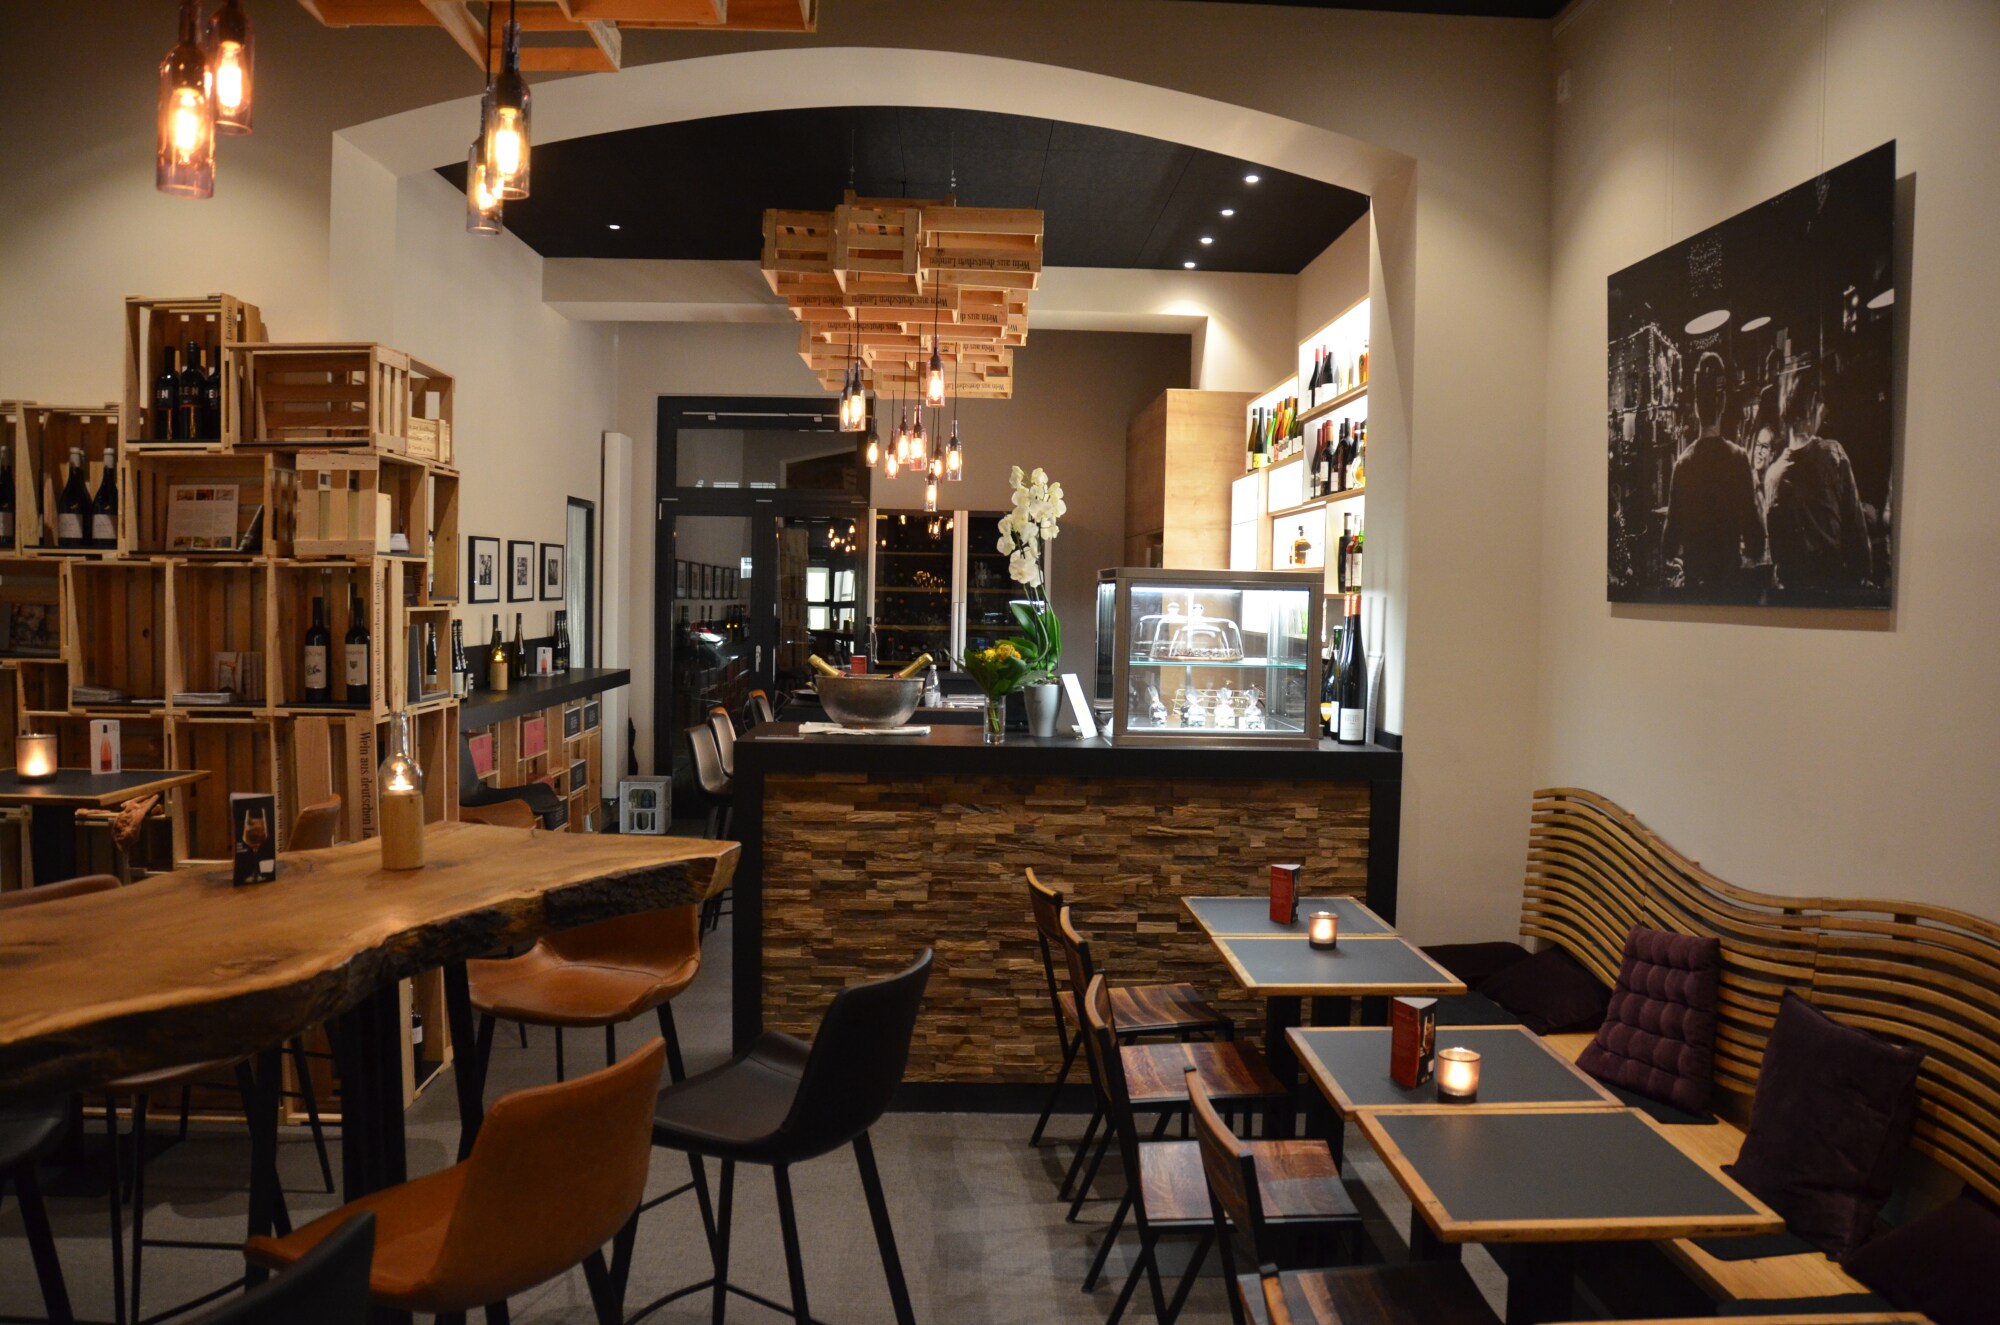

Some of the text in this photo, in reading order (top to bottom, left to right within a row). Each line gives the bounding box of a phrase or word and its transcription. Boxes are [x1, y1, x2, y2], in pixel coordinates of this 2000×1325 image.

[996, 259, 1011, 267] aus
[1012, 260, 1030, 271] Wein
[981, 313, 998, 323] Wein
[360, 731, 371, 755] Wein
[360, 758, 369, 775] aus
[361, 778, 373, 825] deutschen
